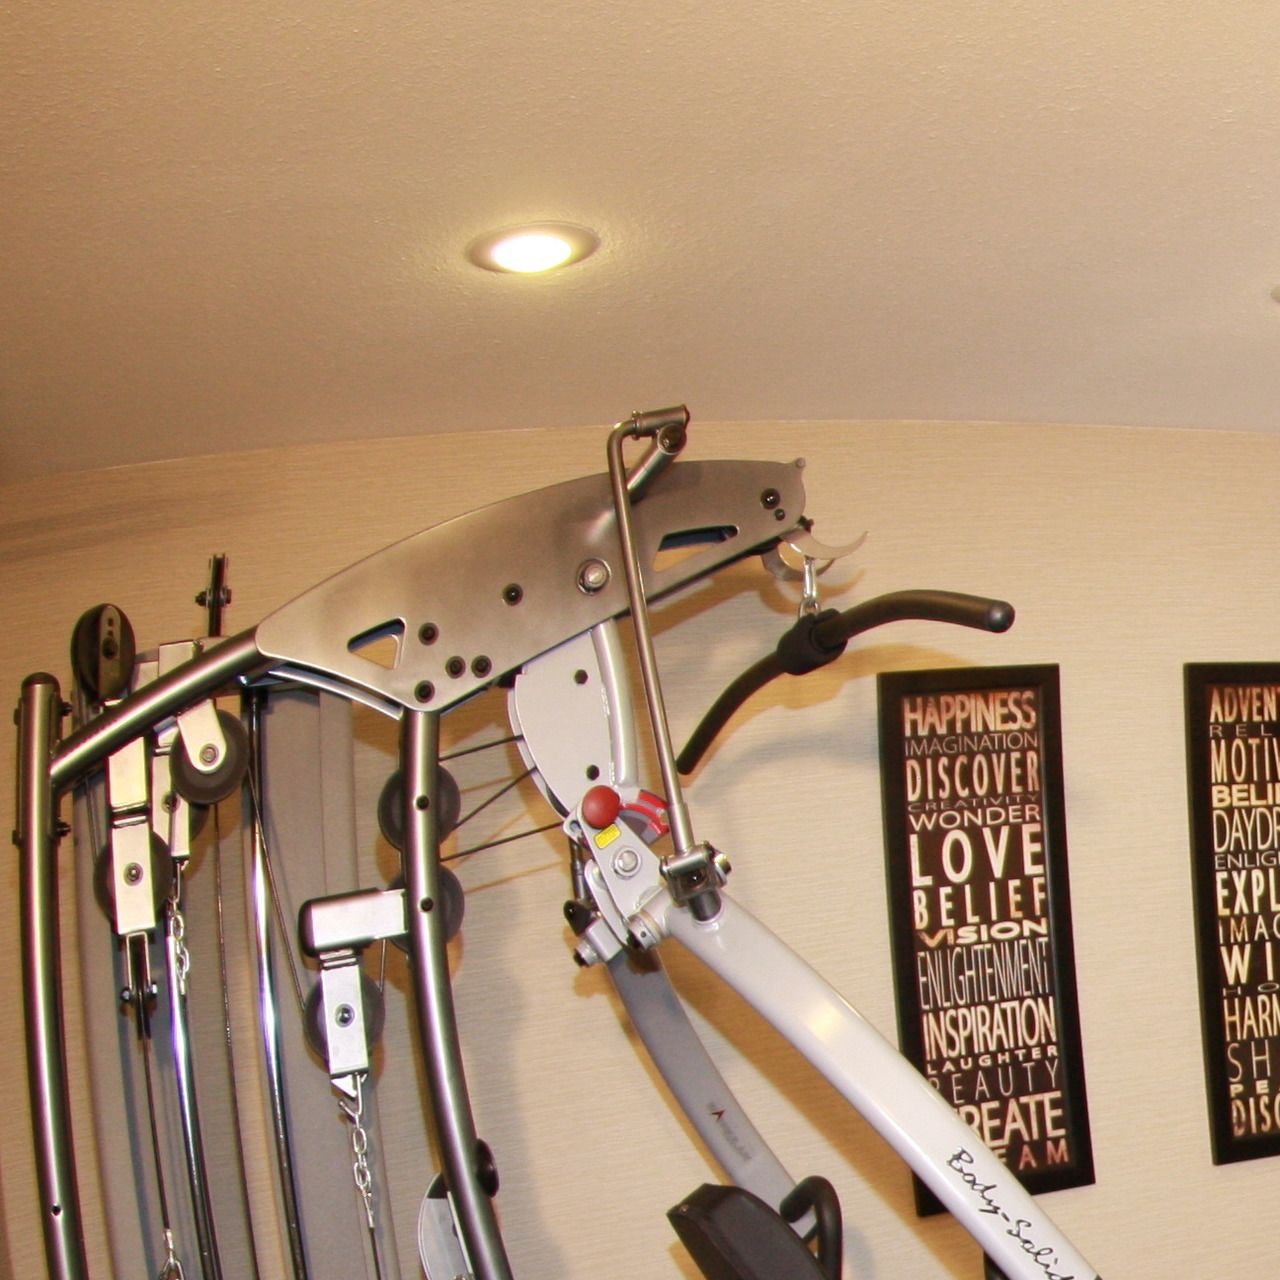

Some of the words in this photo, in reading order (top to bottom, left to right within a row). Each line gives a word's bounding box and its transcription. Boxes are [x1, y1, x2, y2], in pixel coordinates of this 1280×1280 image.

[903, 689, 1037, 737] HAPPINESS
[904, 731, 1039, 757] IMAGINATION
[905, 750, 1041, 802] DISCOVER
[907, 793, 1038, 813] CREATIVITY
[909, 803, 1042, 832] WONDER
[909, 823, 1044, 887] LOVE
[912, 876, 1047, 930] BELIEF
[916, 918, 1049, 948] VISION
[917, 937, 1050, 1011] ENLIGHTENMENT
[922, 996, 1057, 1061] INSPIRATION
[926, 1045, 1059, 1075] LAUGHTER
[954, 1090, 1067, 1149] REATE
